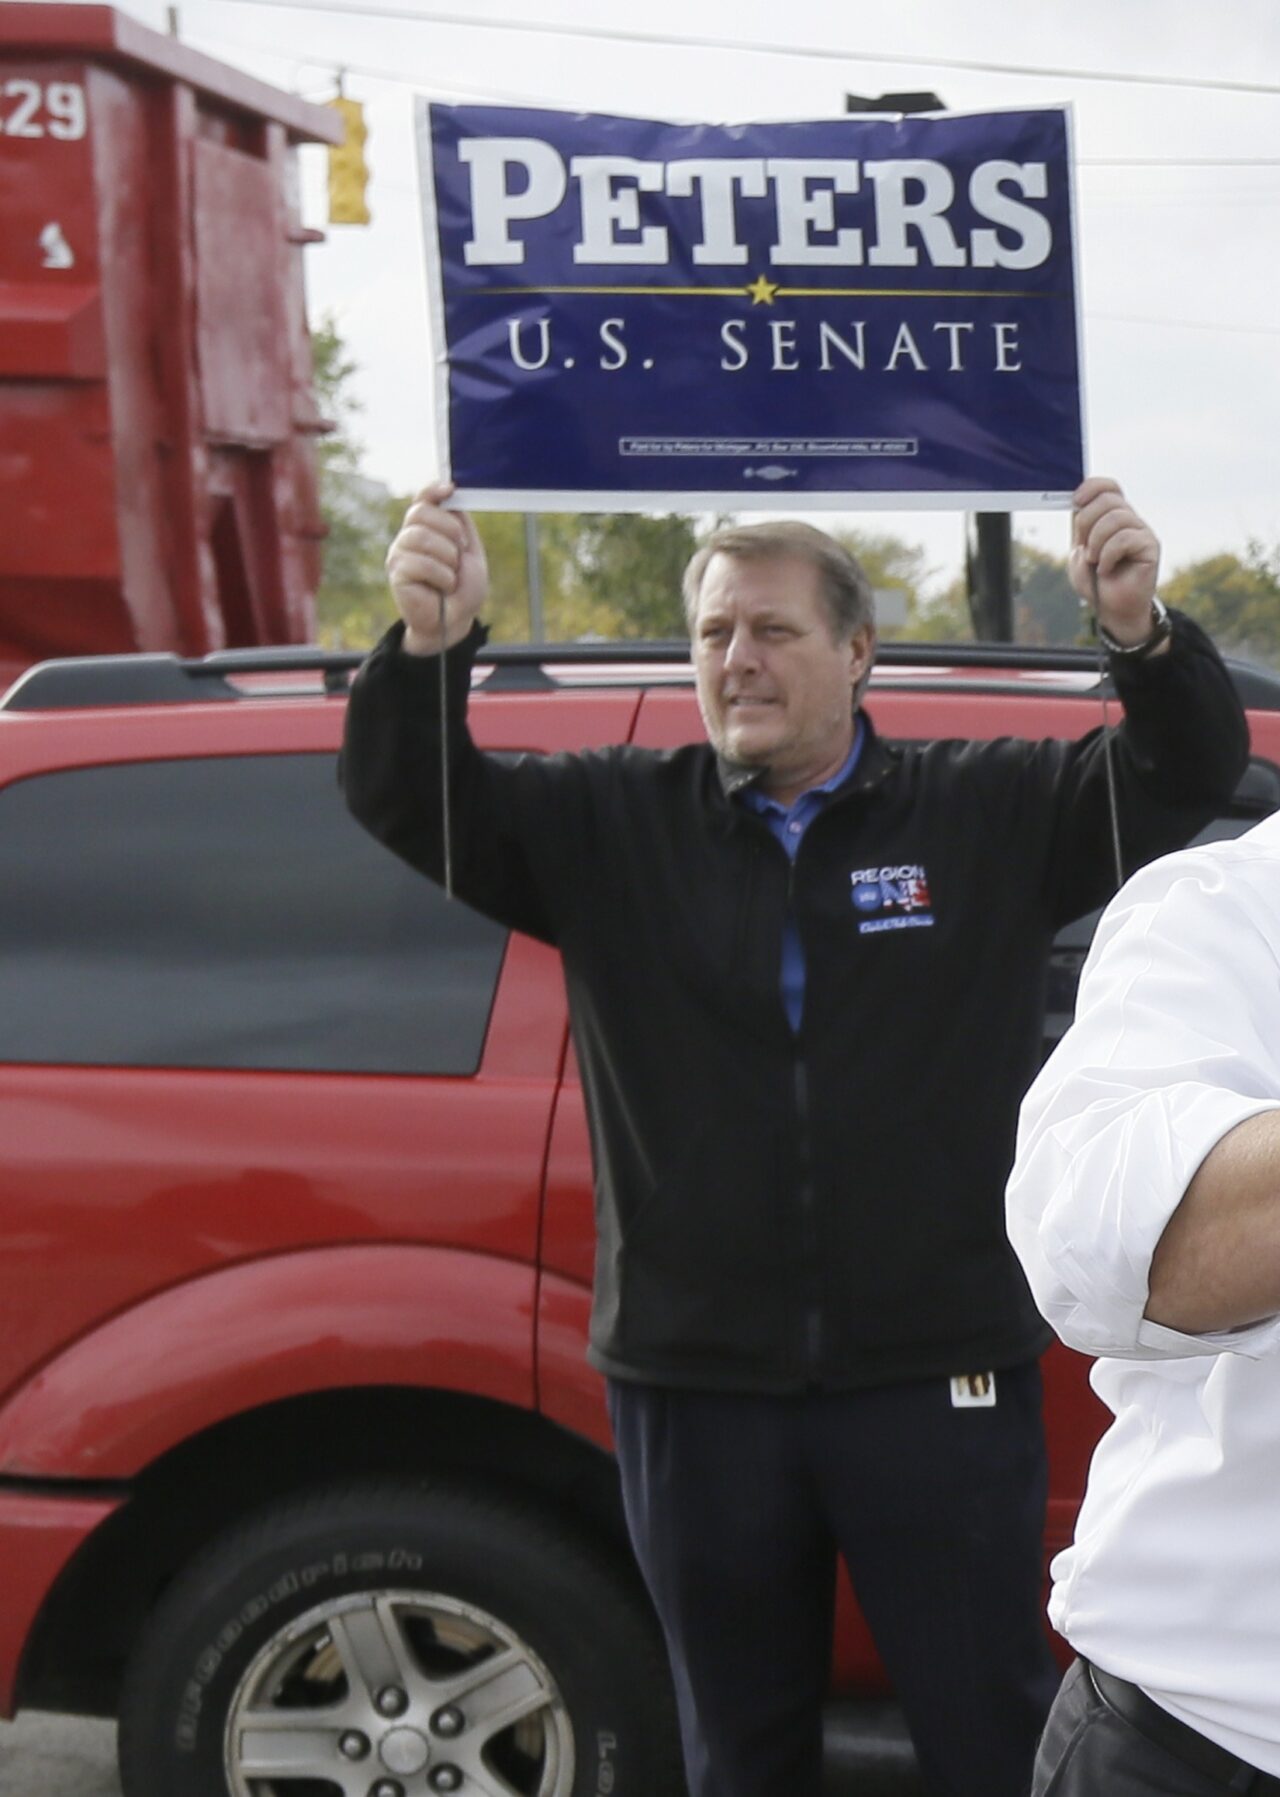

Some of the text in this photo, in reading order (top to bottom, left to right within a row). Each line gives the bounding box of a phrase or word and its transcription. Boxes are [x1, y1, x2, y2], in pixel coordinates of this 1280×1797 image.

[0, 79, 87, 140] 29
[458, 136, 1052, 269] PETERS
[506, 318, 1022, 371] U.S. SENATE
[850, 864, 926, 886] REGION
